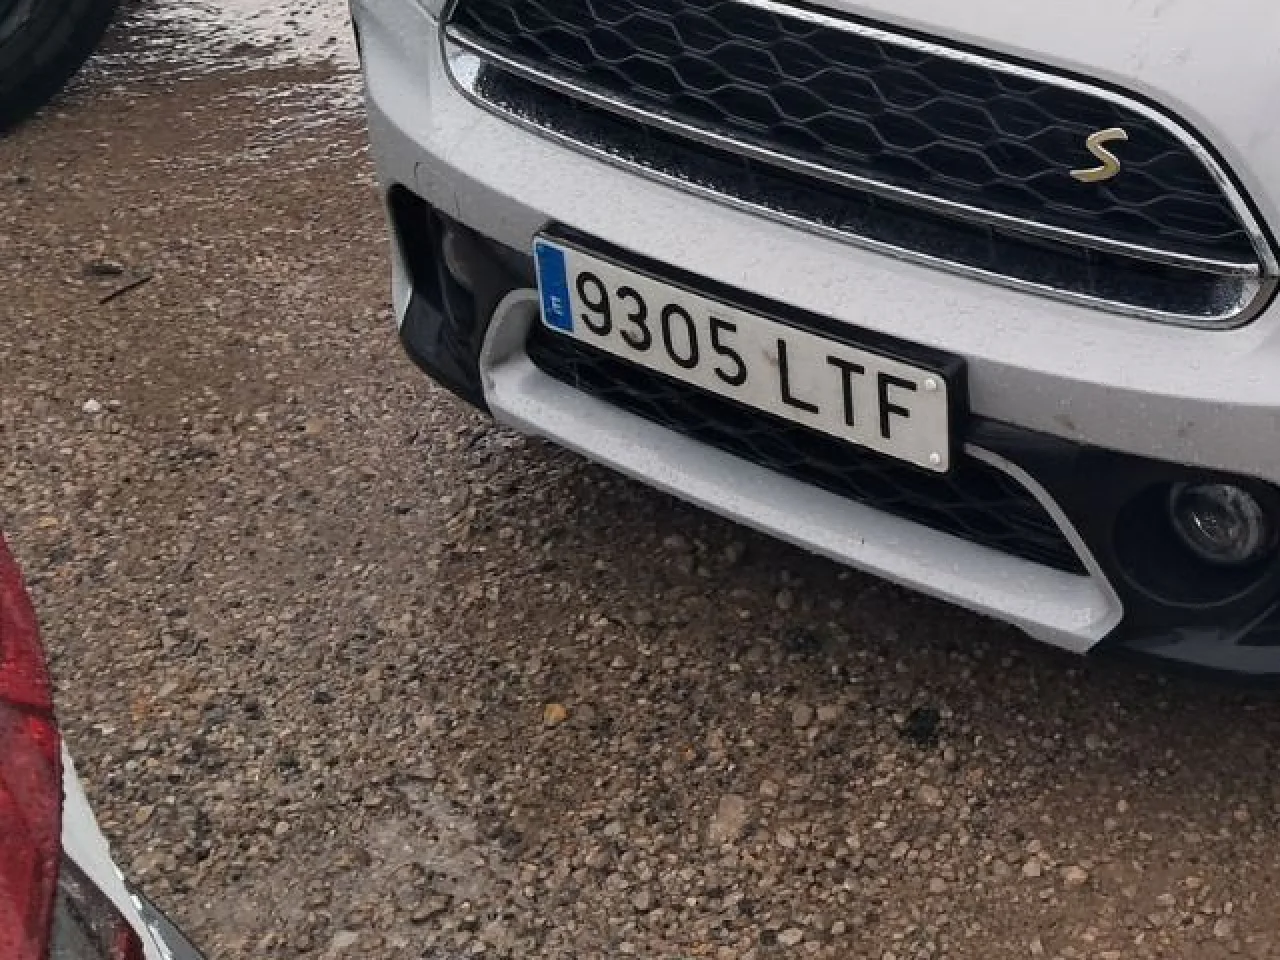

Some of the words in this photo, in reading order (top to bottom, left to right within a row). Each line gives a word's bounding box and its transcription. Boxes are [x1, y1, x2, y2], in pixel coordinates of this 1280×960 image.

[1069, 127, 1129, 182] S
[576, 271, 748, 387] 9305
[777, 337, 918, 440] LTF
